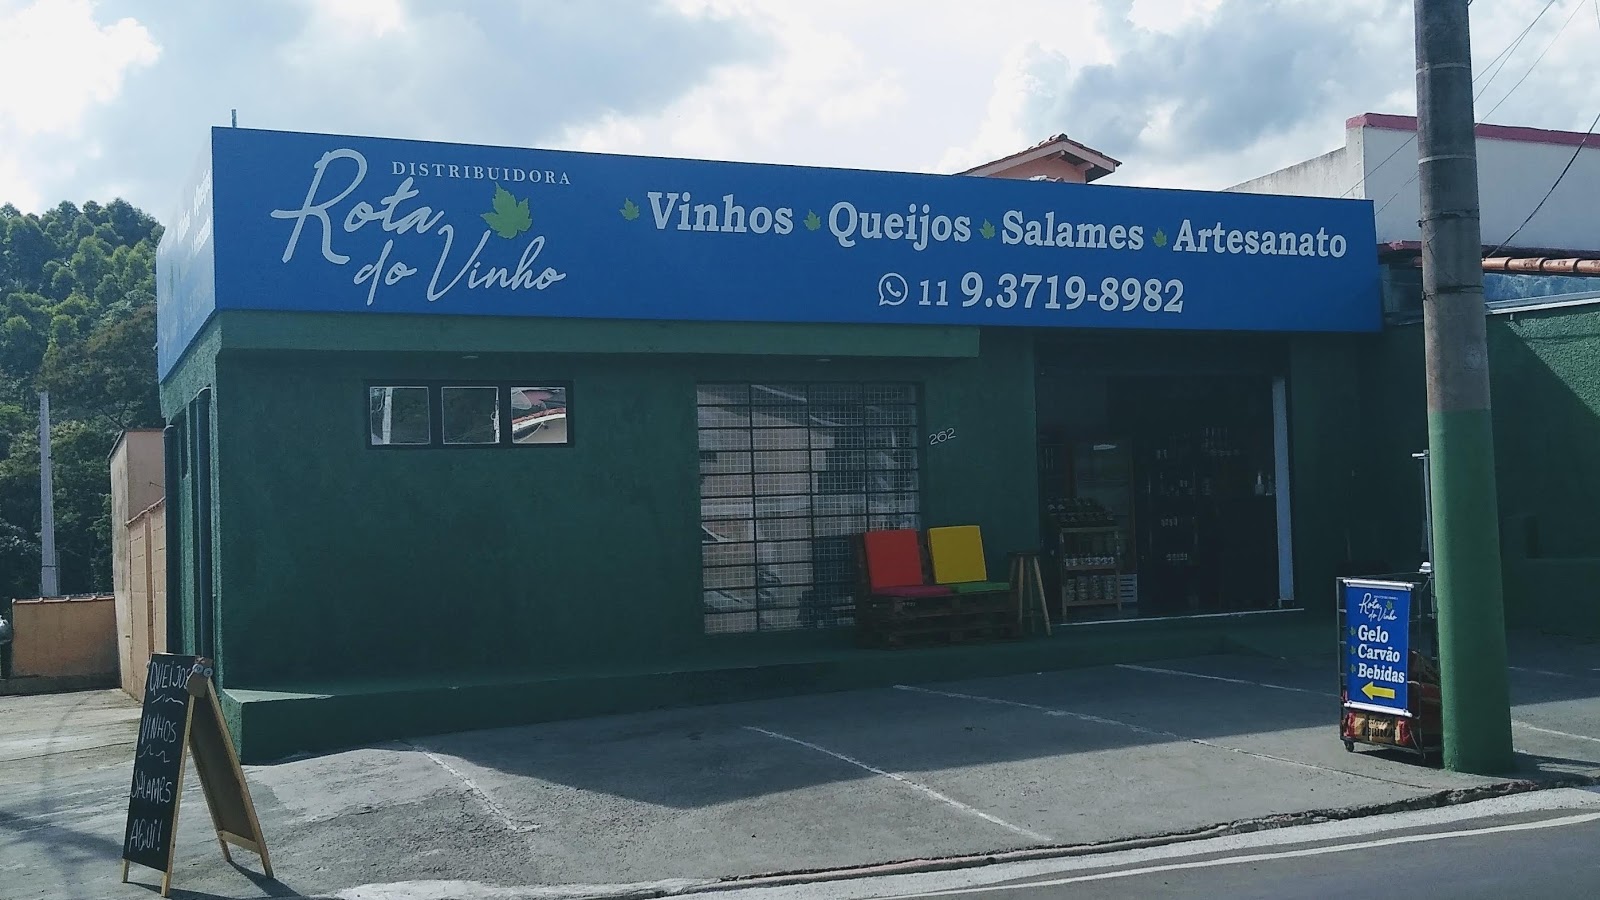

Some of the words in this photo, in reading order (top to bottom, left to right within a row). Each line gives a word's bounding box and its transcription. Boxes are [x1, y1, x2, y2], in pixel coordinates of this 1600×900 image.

[392, 161, 571, 185] DISTRIBUIDORA
[270, 148, 445, 265] Rota
[647, 191, 794, 235] Vinhos
[828, 201, 971, 251] Queijos
[1001, 209, 1144, 251] Salames
[1172, 219, 1347, 258] Artesanato
[353, 239, 418, 306] do
[426, 223, 567, 302] Vinho
[918, 279, 949, 306] 11
[960, 271, 1184, 314] 9.3719-8982
[929, 427, 957, 446] 262
[1359, 592, 1381, 614] Rota
[1357, 624, 1389, 644] Gelo
[1357, 643, 1401, 663] Carvão
[1357, 662, 1405, 684] Bebidas
[141, 713, 177, 743] VINHOS
